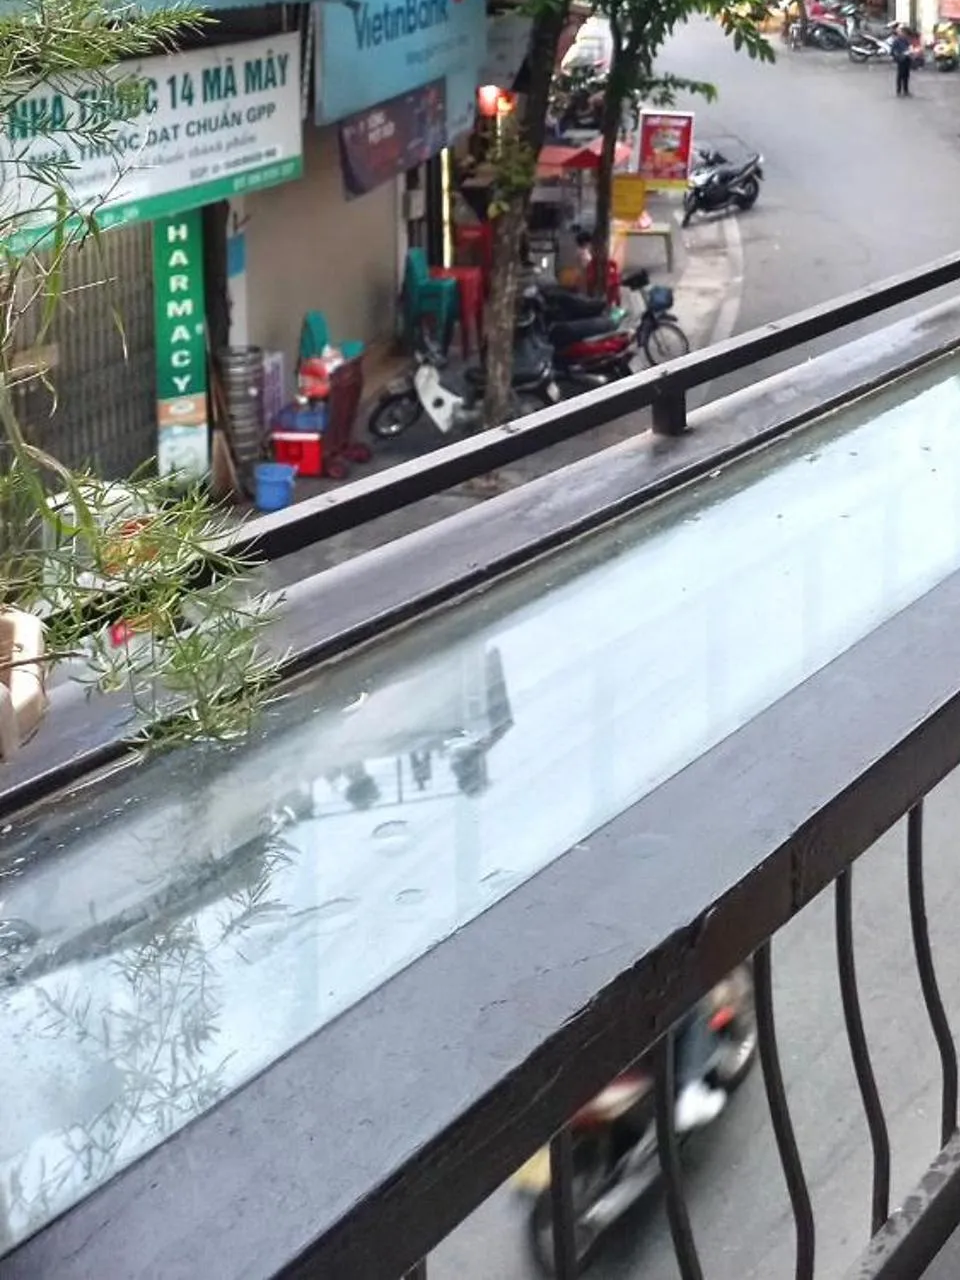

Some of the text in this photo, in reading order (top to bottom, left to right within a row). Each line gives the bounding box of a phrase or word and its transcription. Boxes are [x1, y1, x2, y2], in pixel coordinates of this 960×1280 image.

[166, 72, 195, 110] 14
[202, 57, 237, 104] MÃ
[244, 48, 289, 95] MÂY
[246, 102, 277, 124] GPP
[165, 223, 194, 393] HARMACY
